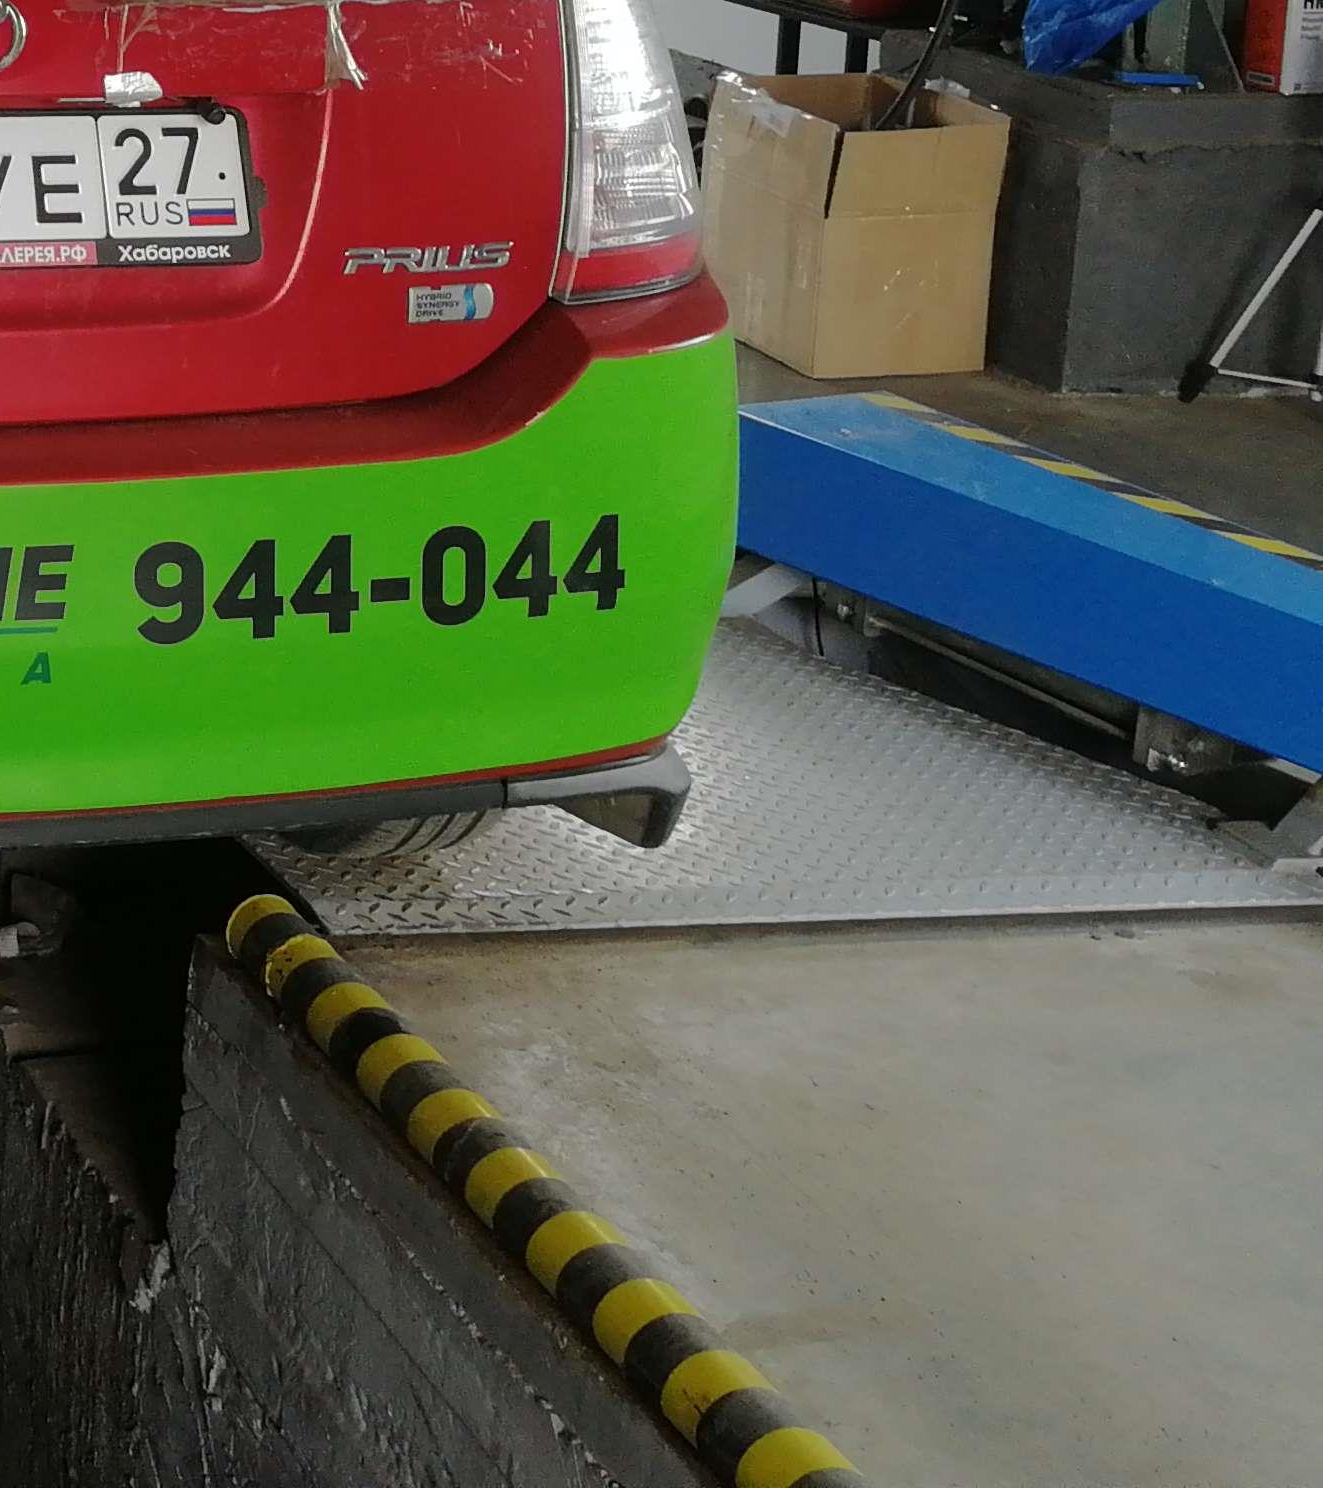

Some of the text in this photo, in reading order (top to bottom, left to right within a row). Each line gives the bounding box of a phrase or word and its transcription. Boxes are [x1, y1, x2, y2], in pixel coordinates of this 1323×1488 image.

[113, 127, 199, 195] 27
[115, 202, 183, 226] RUS
[118, 243, 231, 261] Хабаровск
[343, 241, 514, 274] PRIUS
[134, 514, 625, 645] 944-044
